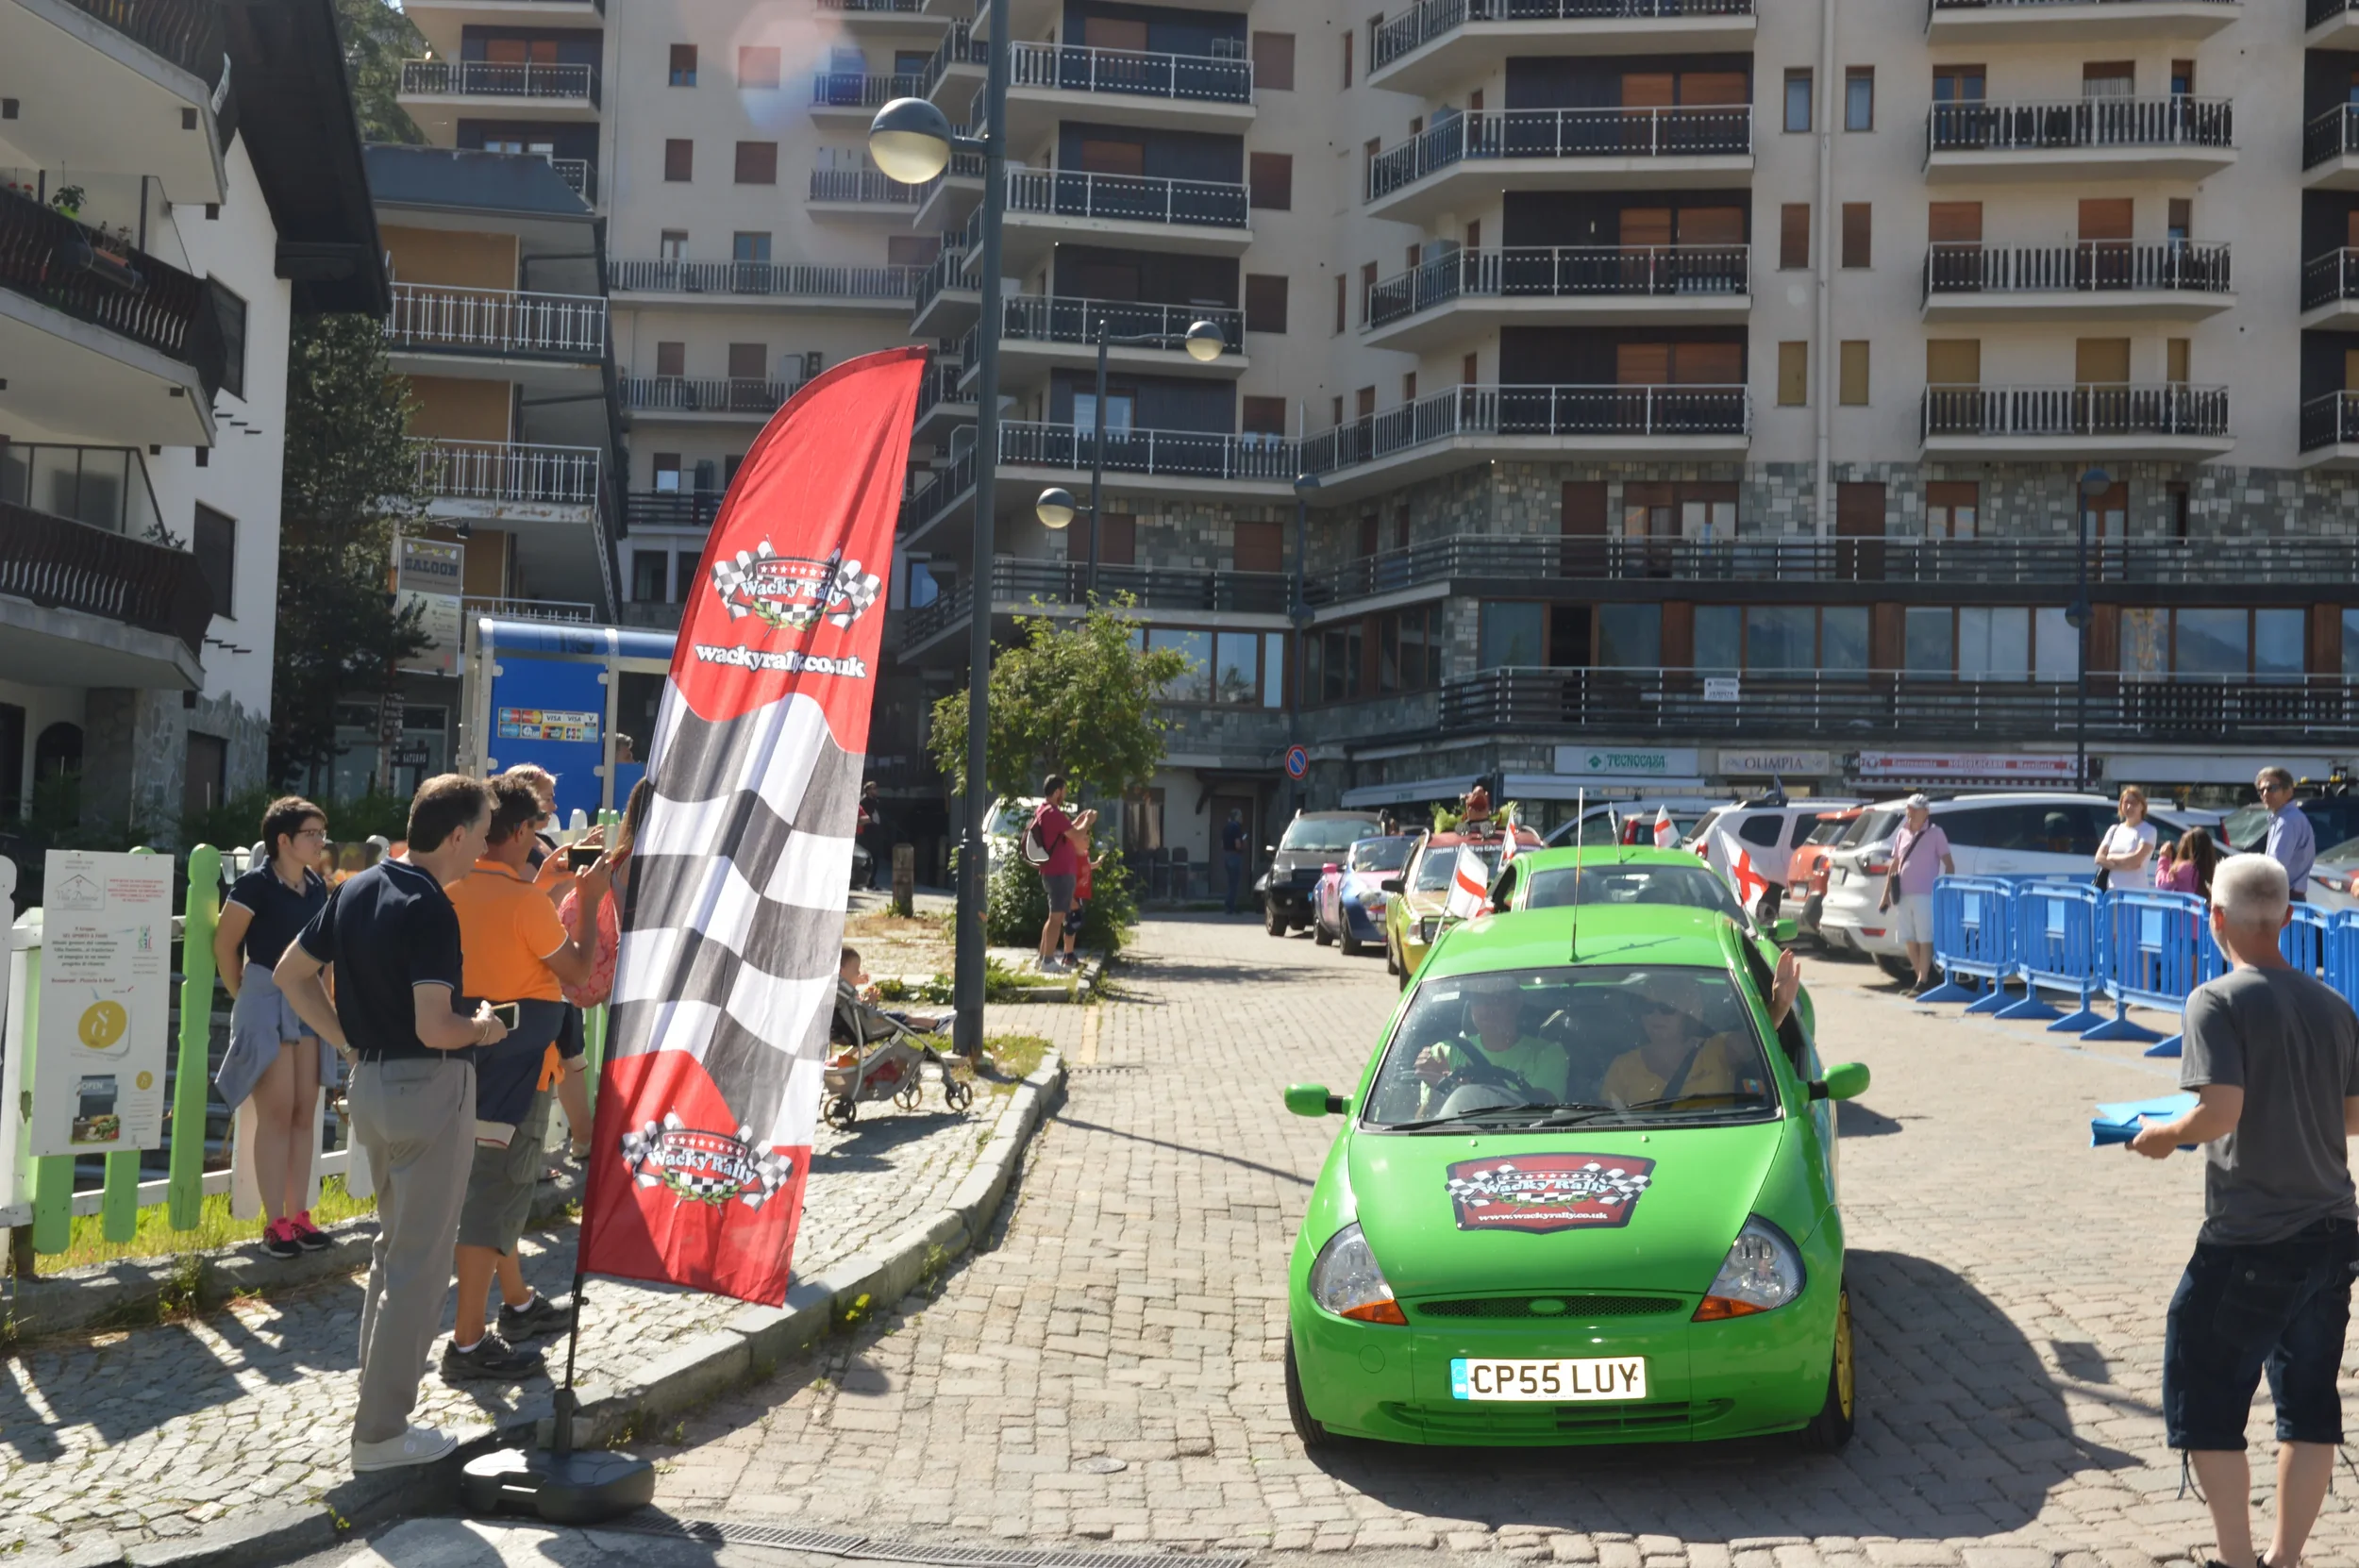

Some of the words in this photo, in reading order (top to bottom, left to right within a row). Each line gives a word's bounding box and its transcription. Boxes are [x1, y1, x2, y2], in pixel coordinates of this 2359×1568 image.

[404, 558, 459, 576] SALOON
[741, 579, 797, 597] Wacky
[802, 580, 846, 606] Rally
[694, 644, 866, 678] wackyrally.co.uk
[1744, 756, 1803, 771] OLIMPIA
[81, 1081, 104, 1091] OPEN
[647, 1150, 708, 1171] Wacky
[711, 1153, 757, 1185] Rally
[1482, 1179, 1549, 1194] Wacky
[1552, 1179, 1613, 1193] Rally
[1478, 1212, 1608, 1222] www.wackyrally.co.uk
[1473, 1364, 1561, 1394] CP55
[1572, 1363, 1638, 1393] LUY
